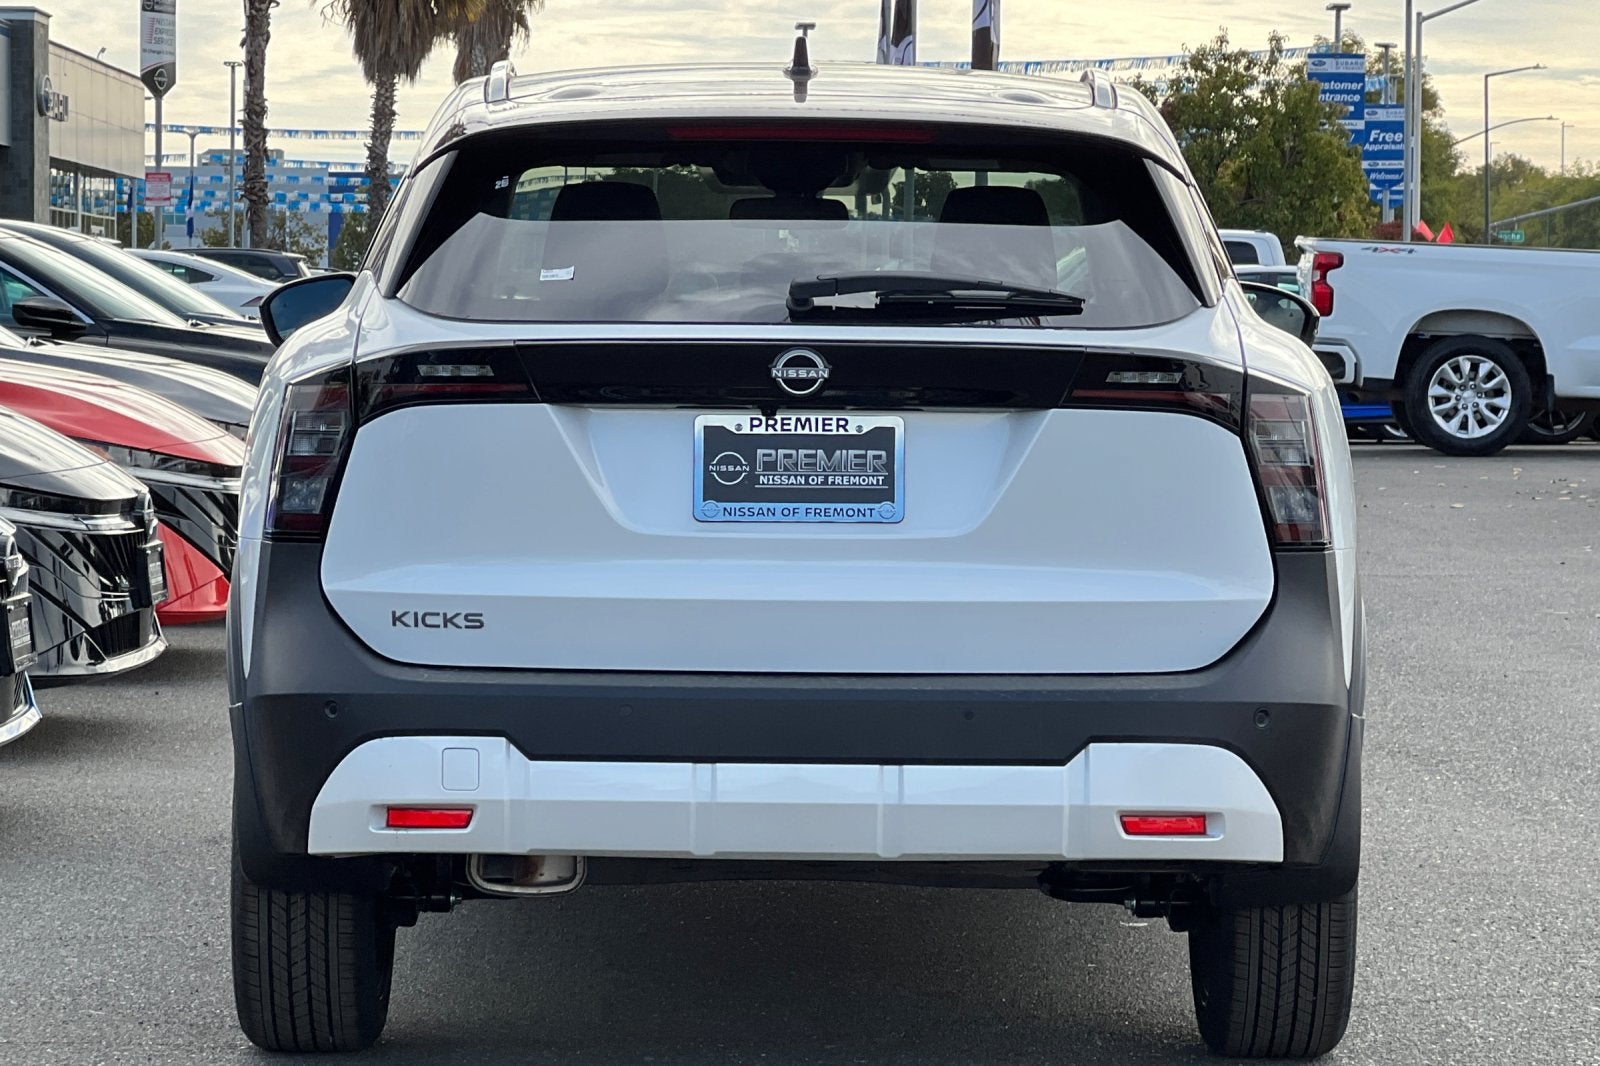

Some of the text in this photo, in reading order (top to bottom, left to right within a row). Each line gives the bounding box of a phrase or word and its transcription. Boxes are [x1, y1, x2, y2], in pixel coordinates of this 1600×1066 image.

[1320, 80, 1364, 91] stomer
[1318, 92, 1361, 102] ntrance
[1369, 129, 1404, 142] Free
[772, 369, 829, 379] NISSAN
[749, 416, 850, 433] PREMIER
[756, 448, 888, 473] PREMIER
[759, 475, 885, 486] NISSAN OF FREMONT
[722, 506, 776, 517] NISSAN
[781, 507, 800, 518] OF
[804, 507, 876, 518] FREMONT
[391, 610, 485, 629] KICKS
